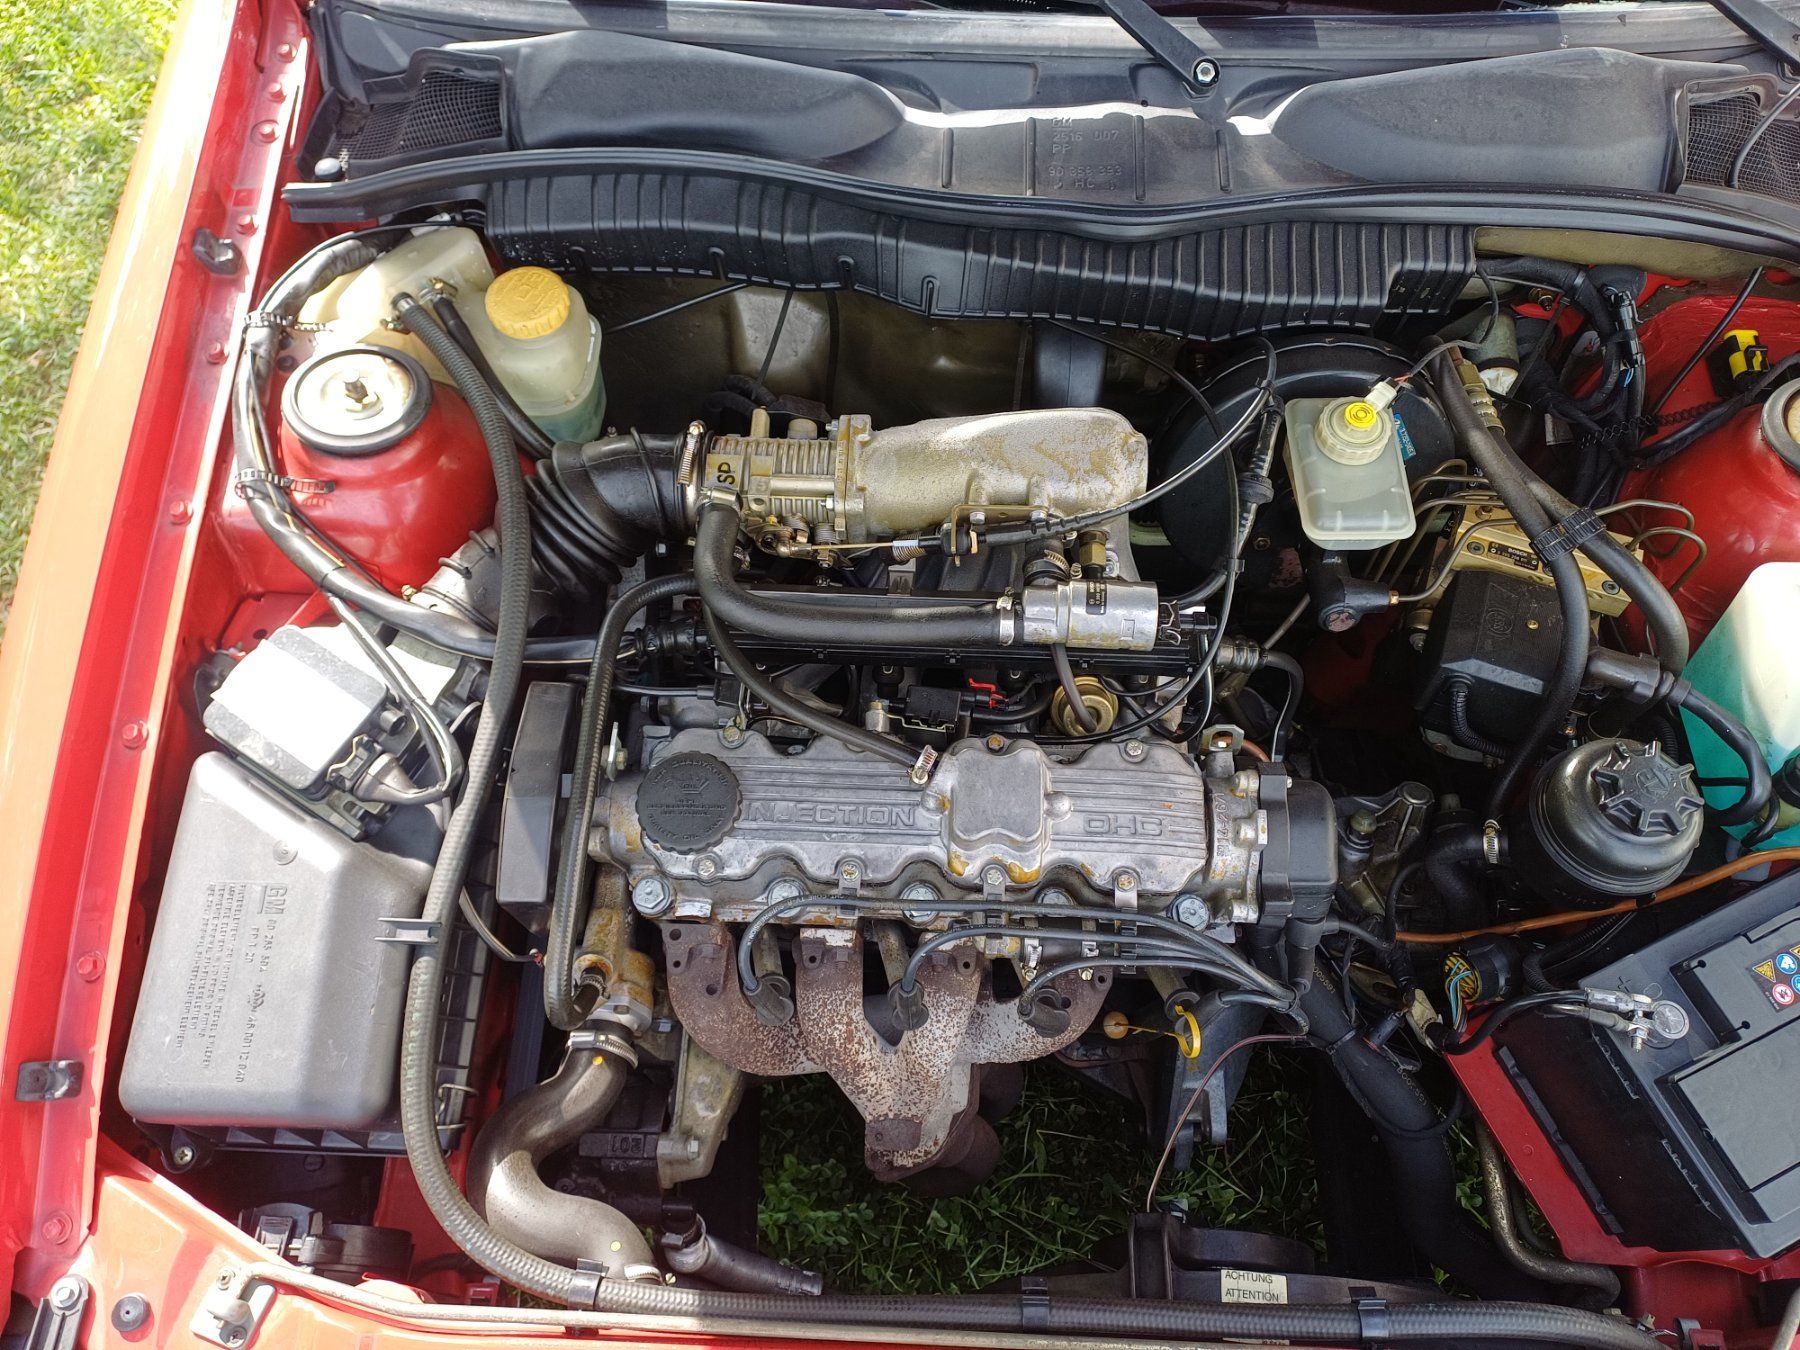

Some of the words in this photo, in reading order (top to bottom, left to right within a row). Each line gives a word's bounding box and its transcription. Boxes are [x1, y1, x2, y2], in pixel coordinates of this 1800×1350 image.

[1052, 143, 1072, 154] PP
[1048, 166, 1064, 176] 90
[744, 801, 915, 827] INJECTION
[1083, 814, 1162, 837] OHC
[264, 886, 288, 914] GM
[1225, 1270, 1273, 1284] ACHTUNG
[1225, 1288, 1279, 1303] ATTENTION
